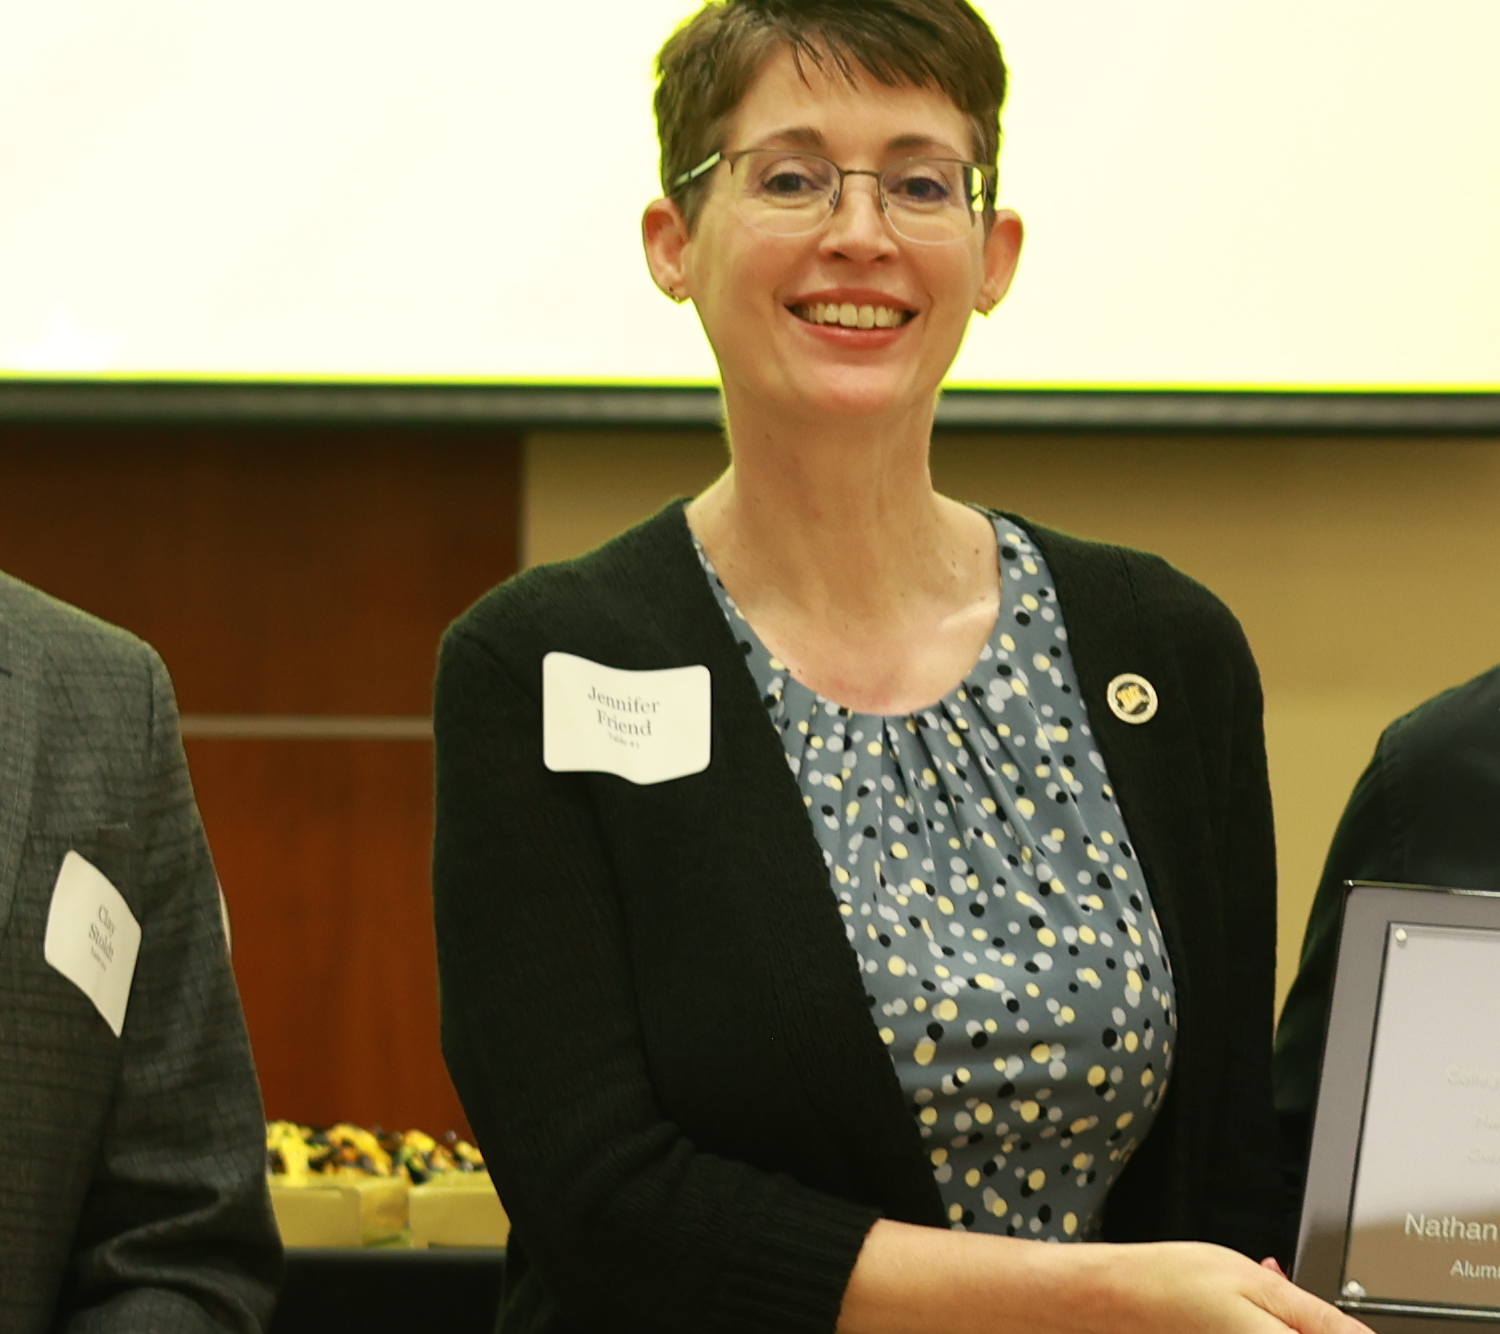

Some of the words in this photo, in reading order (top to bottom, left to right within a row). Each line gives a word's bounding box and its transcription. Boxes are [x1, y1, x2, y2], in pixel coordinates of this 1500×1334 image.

[588, 685, 660, 714] Jennifer
[596, 707, 652, 737] Friend
[1404, 1212, 1499, 1243] Nathan
